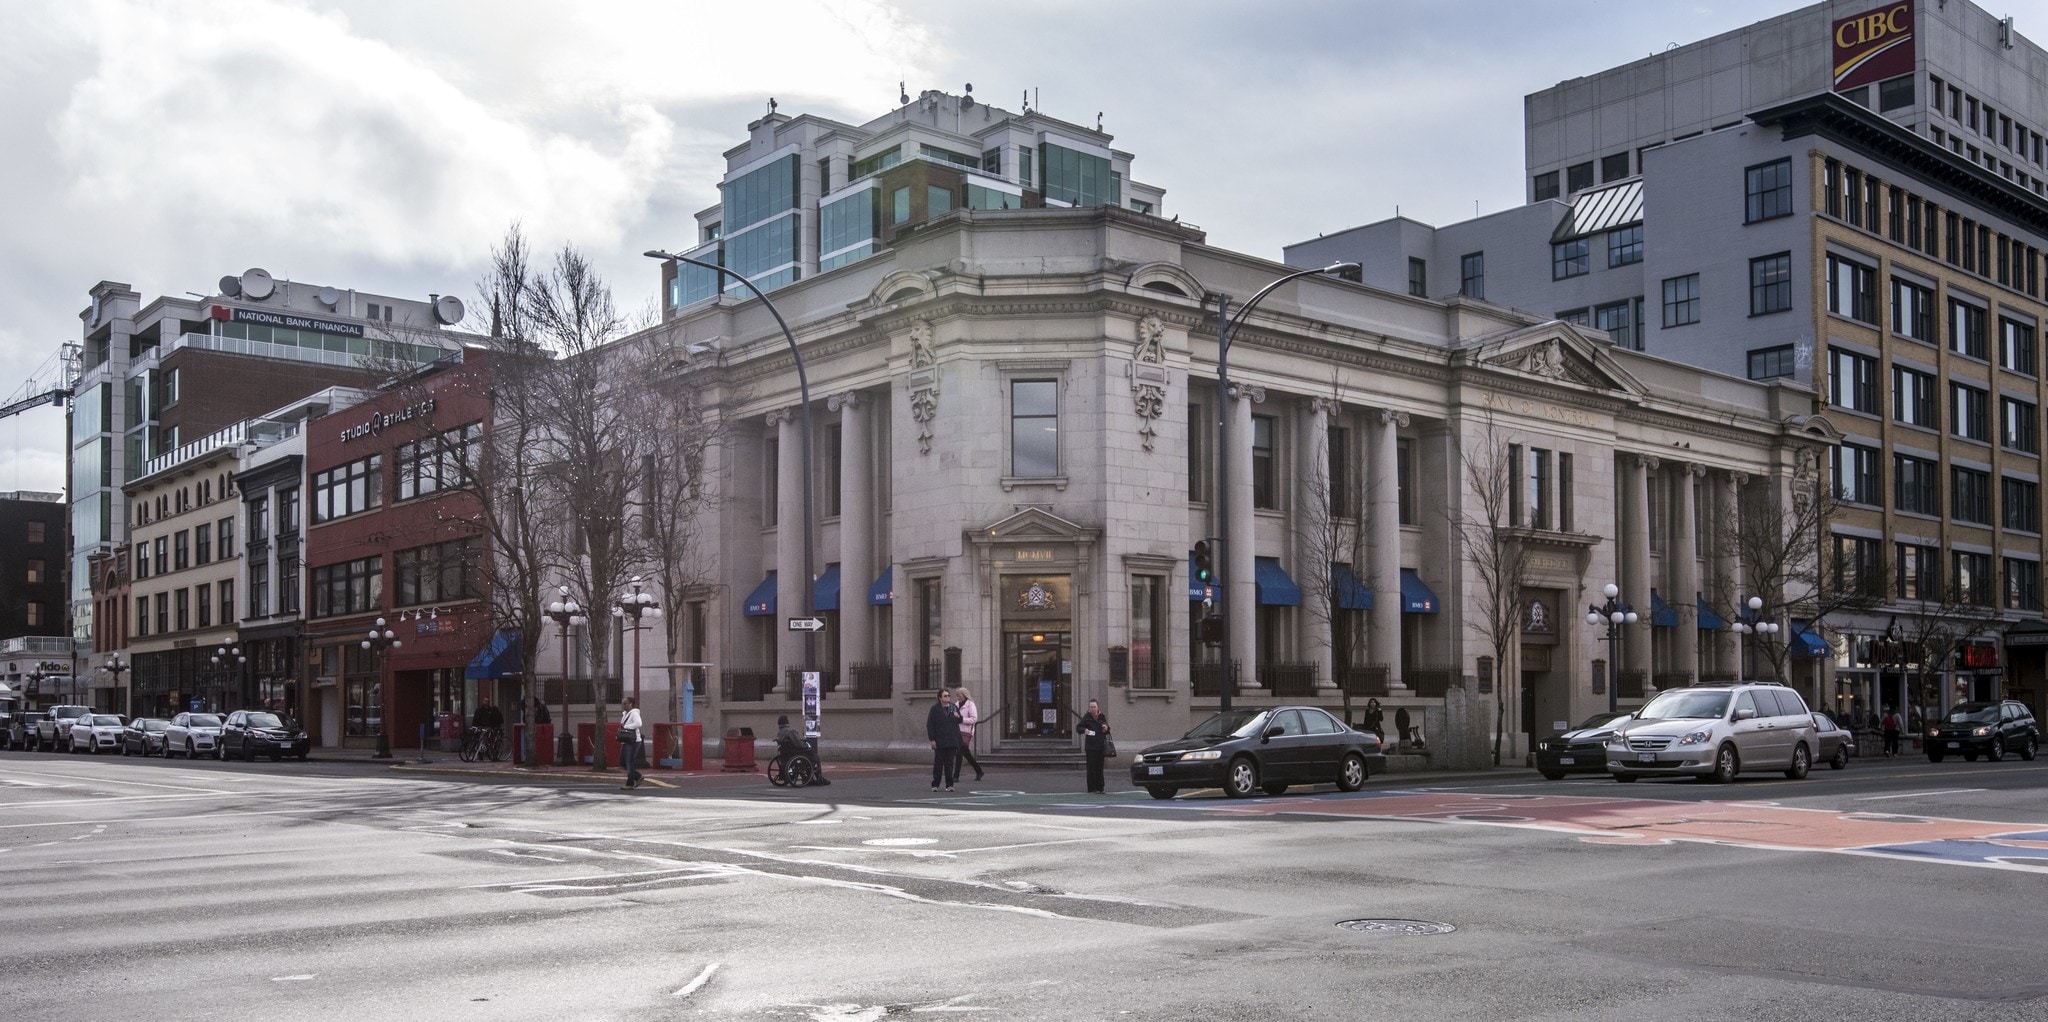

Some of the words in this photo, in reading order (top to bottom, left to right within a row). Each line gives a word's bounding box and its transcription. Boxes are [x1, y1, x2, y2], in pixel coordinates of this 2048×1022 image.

[1836, 5, 1908, 48] CIBC
[238, 311, 283, 325] NATIONAL
[286, 317, 311, 328] BANK
[313, 321, 360, 335] FINANCIAL
[1521, 400, 1534, 414] OF
[340, 422, 370, 442] STUDIO
[1189, 588, 1203, 596] BMO
[41, 661, 61, 671] fido
